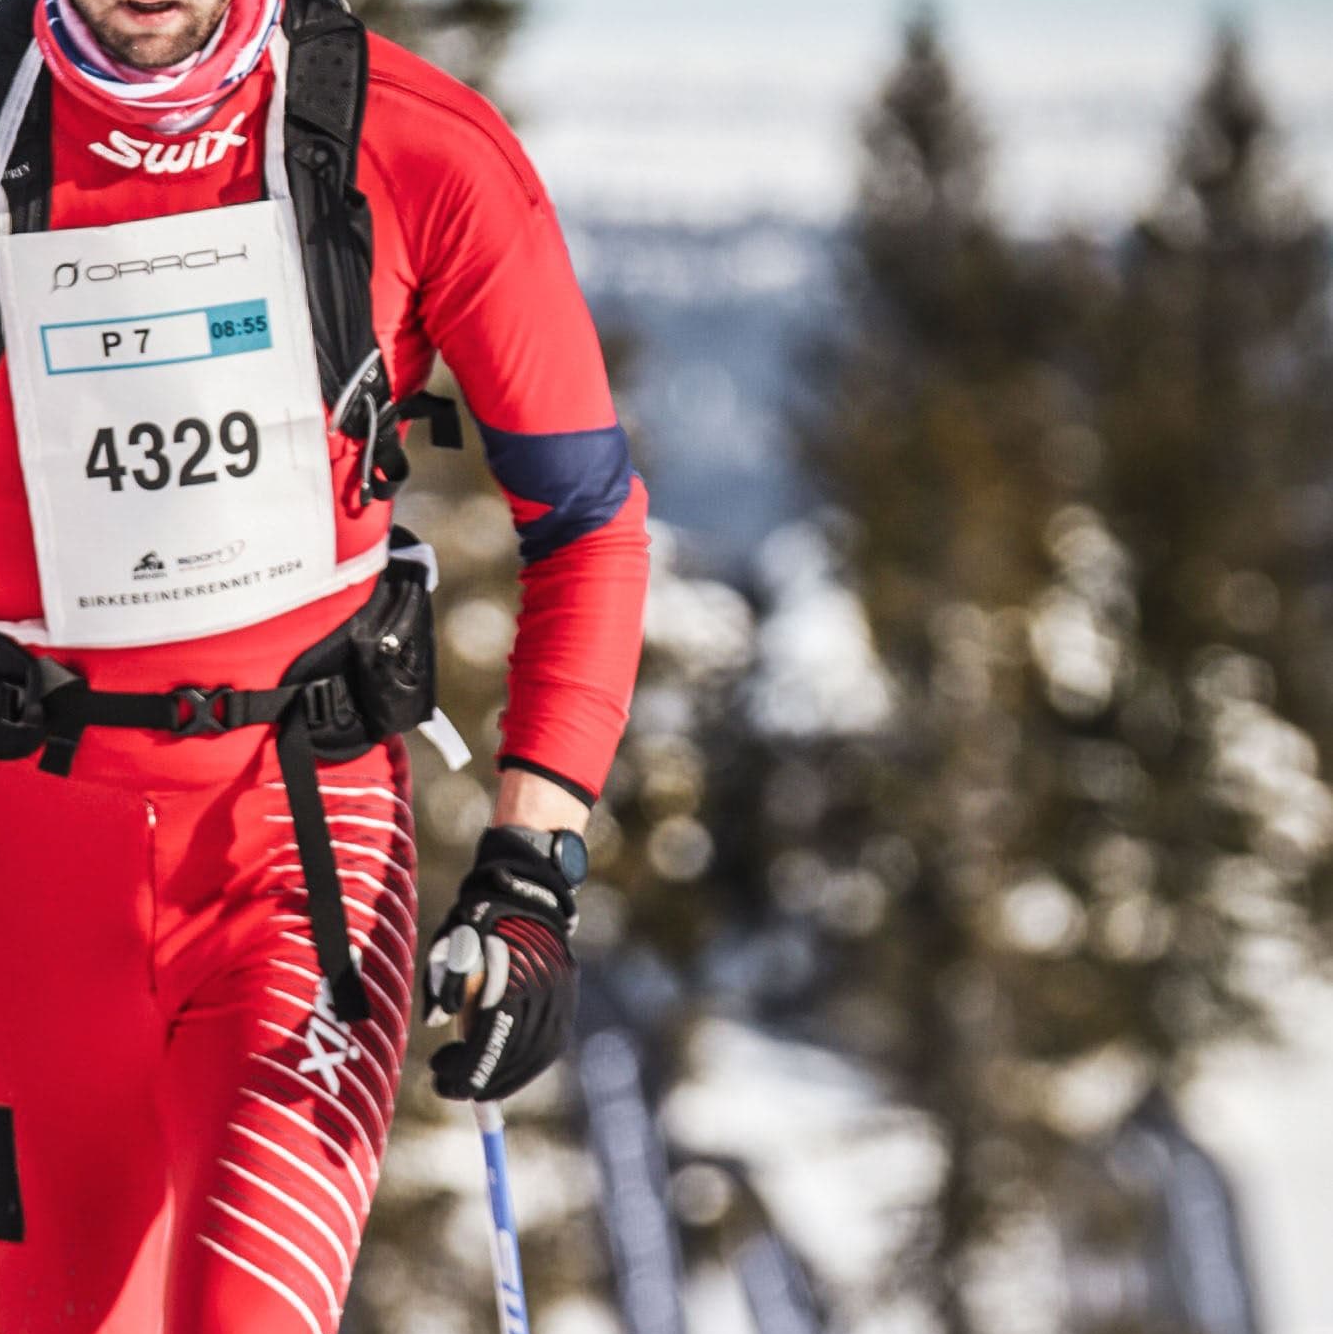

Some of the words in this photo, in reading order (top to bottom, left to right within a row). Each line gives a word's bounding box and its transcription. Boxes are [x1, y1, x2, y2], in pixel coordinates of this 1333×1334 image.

[101, 331, 122, 357] P
[133, 328, 151, 354] 7
[210, 315, 268, 339] 08:55
[86, 410, 260, 491] 4329
[78, 570, 262, 608] BIRKEBEINERRENNET
[269, 559, 303, 579] 2024
